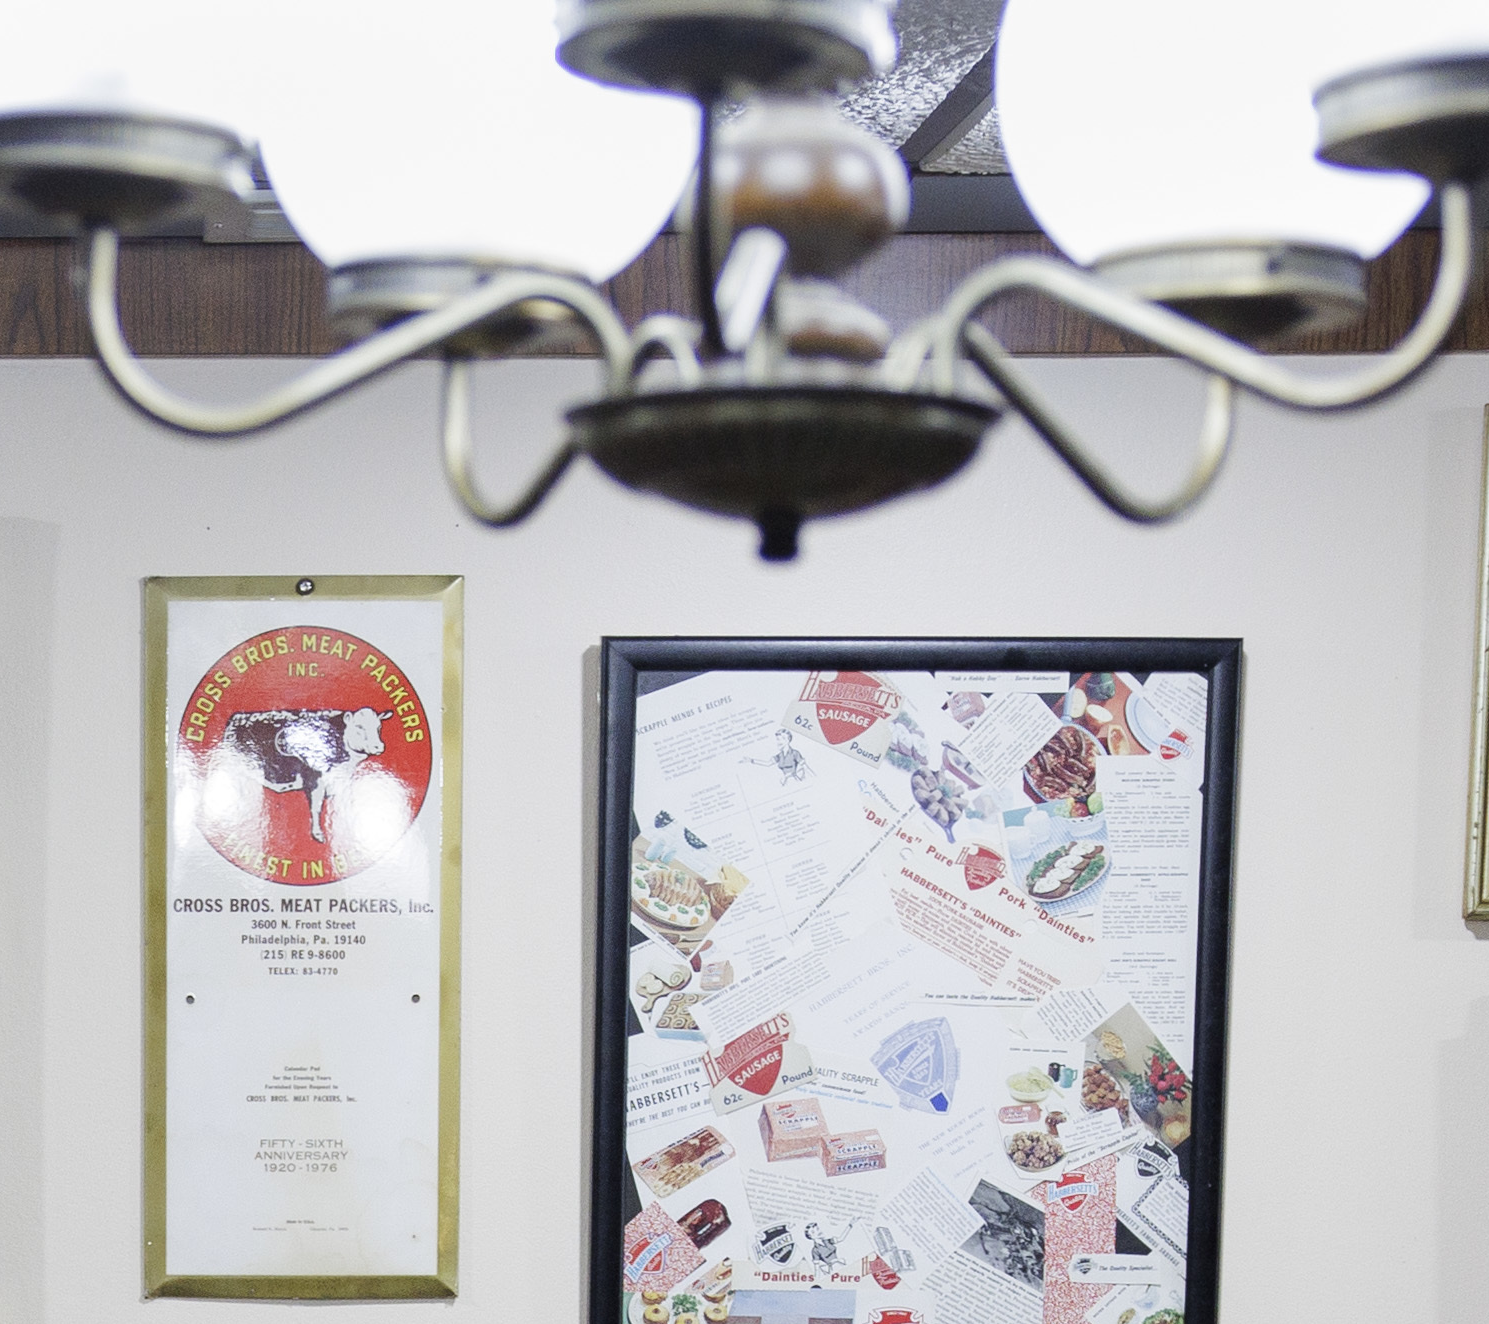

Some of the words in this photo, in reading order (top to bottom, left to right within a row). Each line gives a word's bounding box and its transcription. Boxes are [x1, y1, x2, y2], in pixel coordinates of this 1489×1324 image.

[288, 663, 325, 677] INC.
[186, 671, 232, 742] CROSS
[231, 636, 295, 674] BROS.
[302, 634, 358, 661] MEAT
[360, 654, 424, 743] PACKERS
[636, 718, 668, 736] SCRAPPLE
[671, 707, 695, 723] MENUS
[705, 695, 733, 711] RECIPES
[818, 708, 872, 728] SAUSAGE
[849, 741, 881, 764] Pound
[926, 844, 953, 867] Pure
[302, 860, 325, 878] IN
[901, 866, 968, 910] HABBERSETT'S
[173, 899, 223, 912] CROSS
[230, 899, 274, 912] BROS.
[281, 899, 322, 912] MEAT
[329, 899, 403, 915] PACKERS,
[409, 899, 434, 913] Inc.
[999, 887, 1027, 910] Pork
[251, 920, 277, 929] 3600
[281, 920, 291, 929] N.
[295, 920, 321, 929] Front
[326, 920, 356, 929] Street
[241, 935, 310, 947] Philadelphia,
[314, 935, 329, 945] Pa.
[334, 935, 366, 945] 19140
[260, 950, 287, 961] (215)
[291, 950, 305, 960] RE
[308, 950, 346, 960] 9-8600
[268, 967, 299, 976] TELEX:
[302, 967, 339, 976] 83-4770
[651, 1072, 682, 1085] PRODUCTS
[684, 1067, 700, 1077] FROM
[662, 1063, 681, 1074] THESE
[734, 1050, 781, 1086] SAUSAGE
[782, 1066, 814, 1085] Pound
[841, 1070, 880, 1087] SCRAPPLE
[723, 1092, 744, 1106] 62c
[649, 1112, 659, 1121] THE
[662, 1108, 675, 1118] BEST
[677, 1104, 688, 1113] YOU
[690, 1101, 701, 1110] CAN
[254, 1151, 349, 1161] ANNIVERSARY
[831, 1272, 861, 1284] Pure
